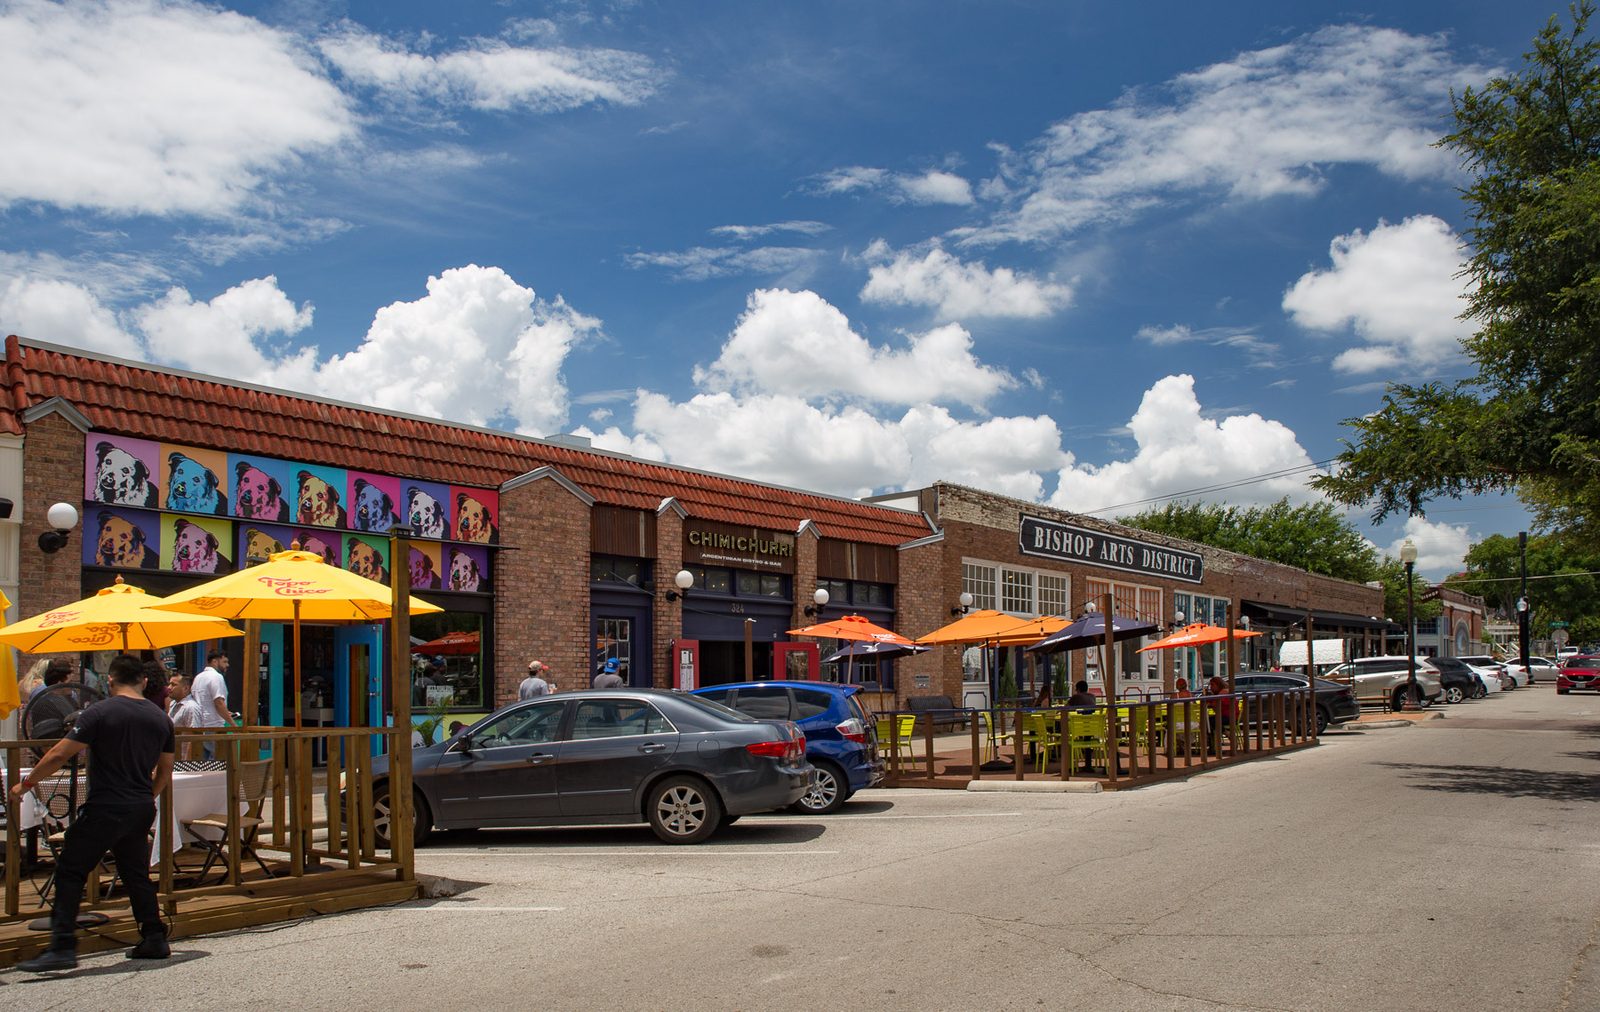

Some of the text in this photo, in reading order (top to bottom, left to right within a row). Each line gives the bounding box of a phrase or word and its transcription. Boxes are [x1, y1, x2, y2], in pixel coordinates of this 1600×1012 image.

[688, 530, 793, 557] CHIMICHURRI
[1034, 526, 1196, 576] BISHOP ARTS DISTRICT
[257, 576, 316, 588] Topo
[273, 586, 333, 596] Chico
[731, 603, 744, 613] 324
